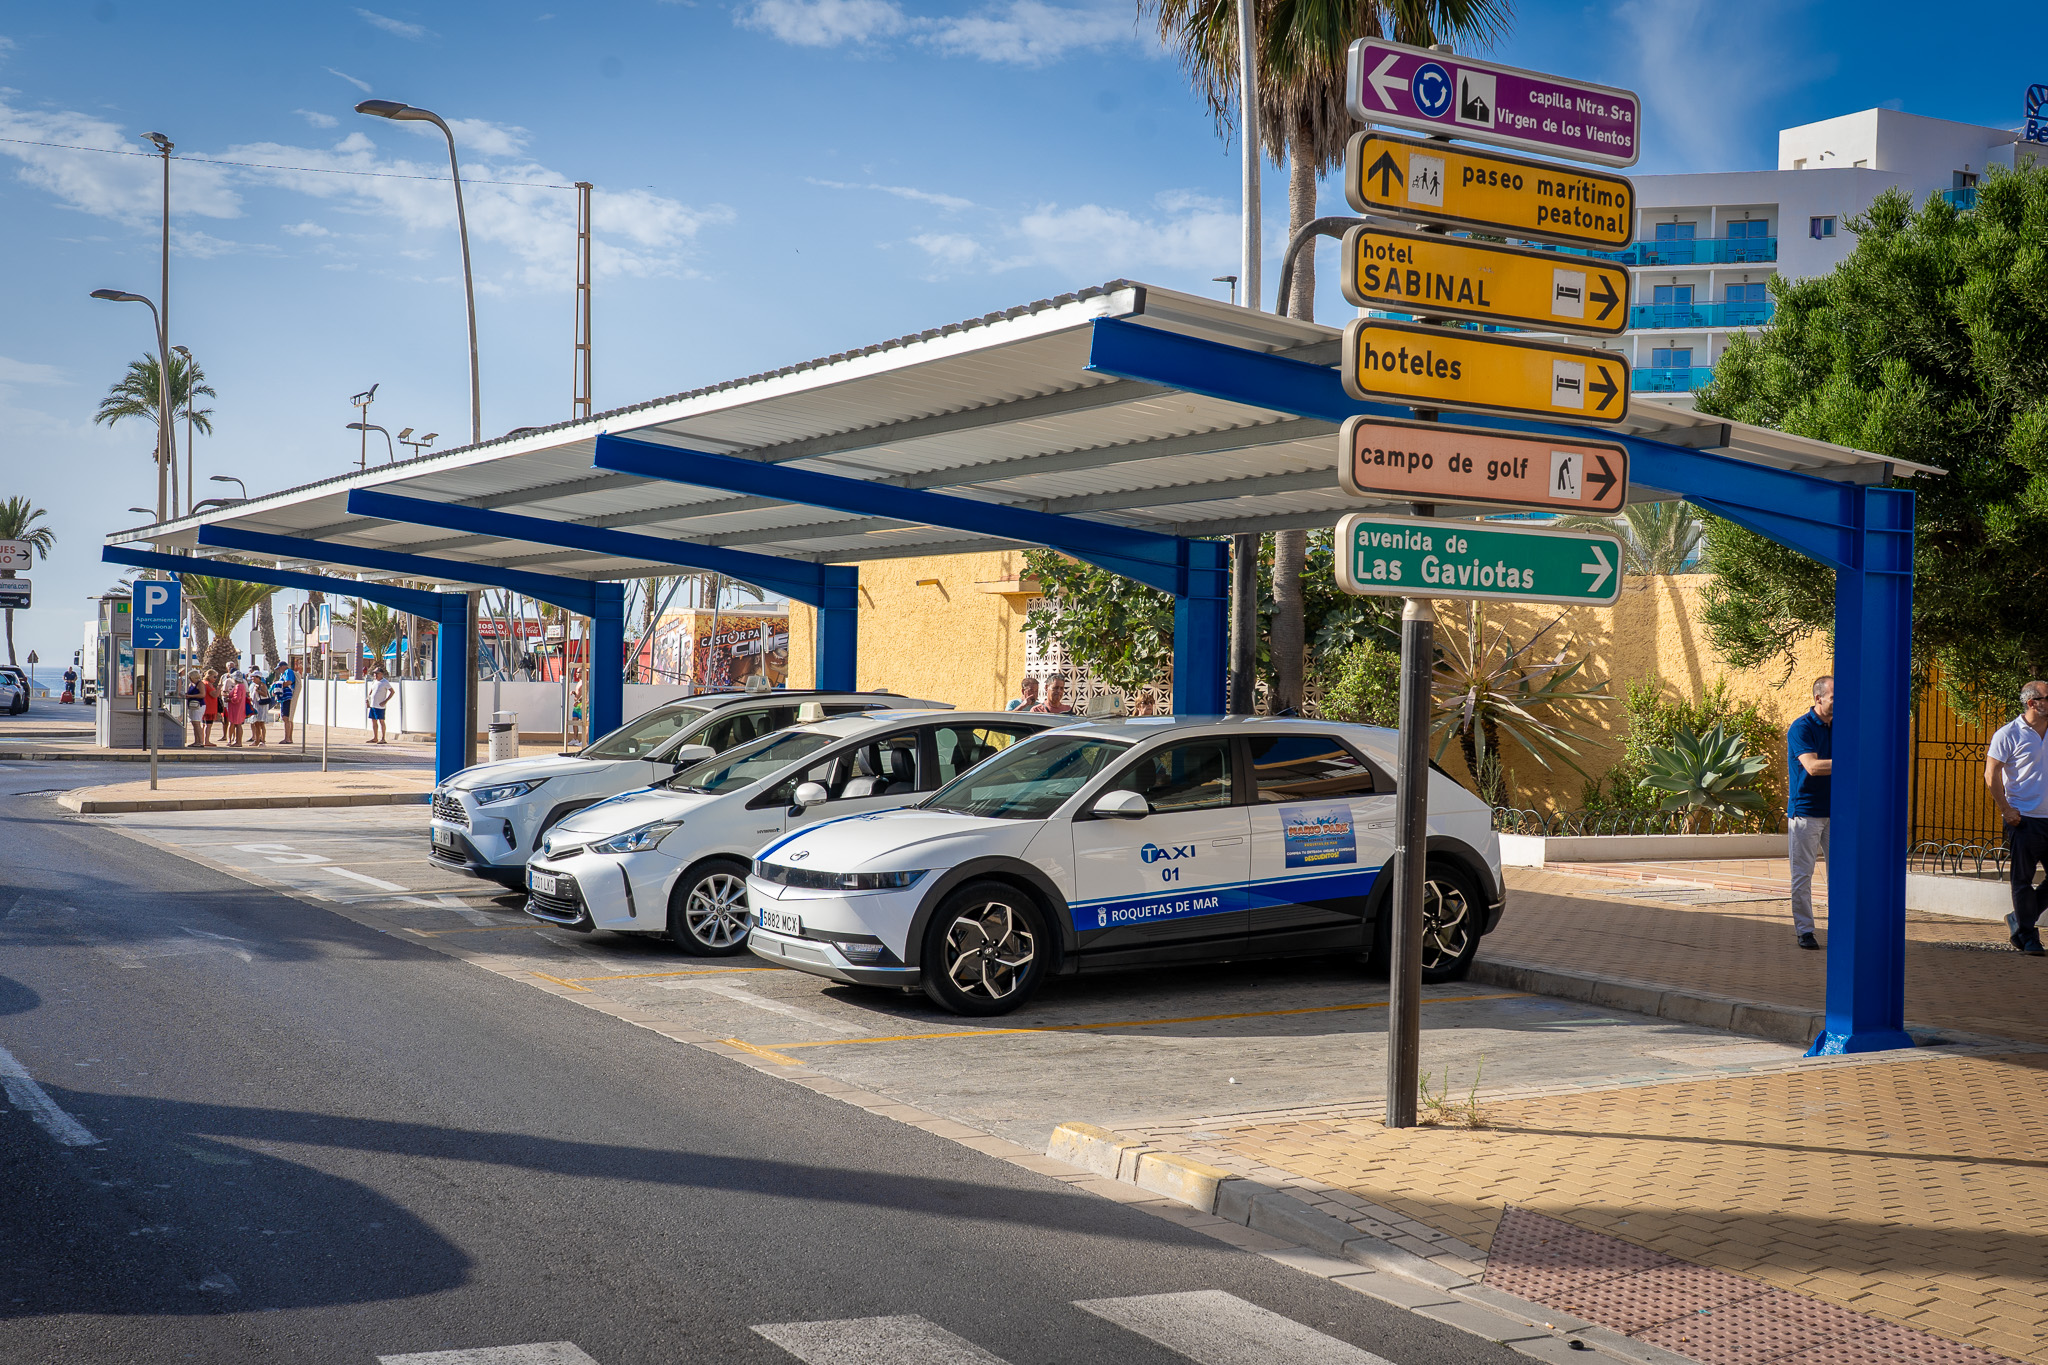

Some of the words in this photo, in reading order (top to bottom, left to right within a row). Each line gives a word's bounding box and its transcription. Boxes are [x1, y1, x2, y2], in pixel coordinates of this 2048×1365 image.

[1529, 91, 1572, 111] capilla
[1576, 98, 1609, 117] Ntra.
[1610, 105, 1632, 122] Sra
[1496, 107, 1537, 129] Virgen
[1542, 117, 1558, 133] de
[1562, 120, 1581, 137] los
[1585, 125, 1632, 147] Vientos
[1462, 165, 1524, 191] paseo
[1537, 177, 1625, 209] marítimo
[1537, 203, 1625, 235] peatonal
[1363, 239, 1414, 265] hotel
[1363, 264, 1491, 307] SABINAL
[1363, 341, 1462, 381] hoteles
[1360, 447, 1434, 474] campo
[1448, 452, 1473, 474] de
[1487, 457, 1529, 481] golf
[1357, 529, 1433, 552] avenida
[1445, 534, 1468, 554] de
[1357, 550, 1402, 581] Las
[1420, 554, 1535, 590] Gaviotas
[145, 585, 169, 615] P
[135, 616, 178, 624] Aparcamiento
[748, 626, 773, 639] PAK
[1288, 824, 1322, 837] MARIO
[1322, 822, 1350, 834] PARK
[1141, 844, 1196, 863] TAXI
[1161, 867, 1180, 882] 01
[763, 911, 780, 929] 5882
[782, 915, 797, 933] MCX
[1111, 903, 1173, 922] ROQUETAS
[1175, 901, 1191, 913] DE
[1192, 896, 1219, 910] MAR
